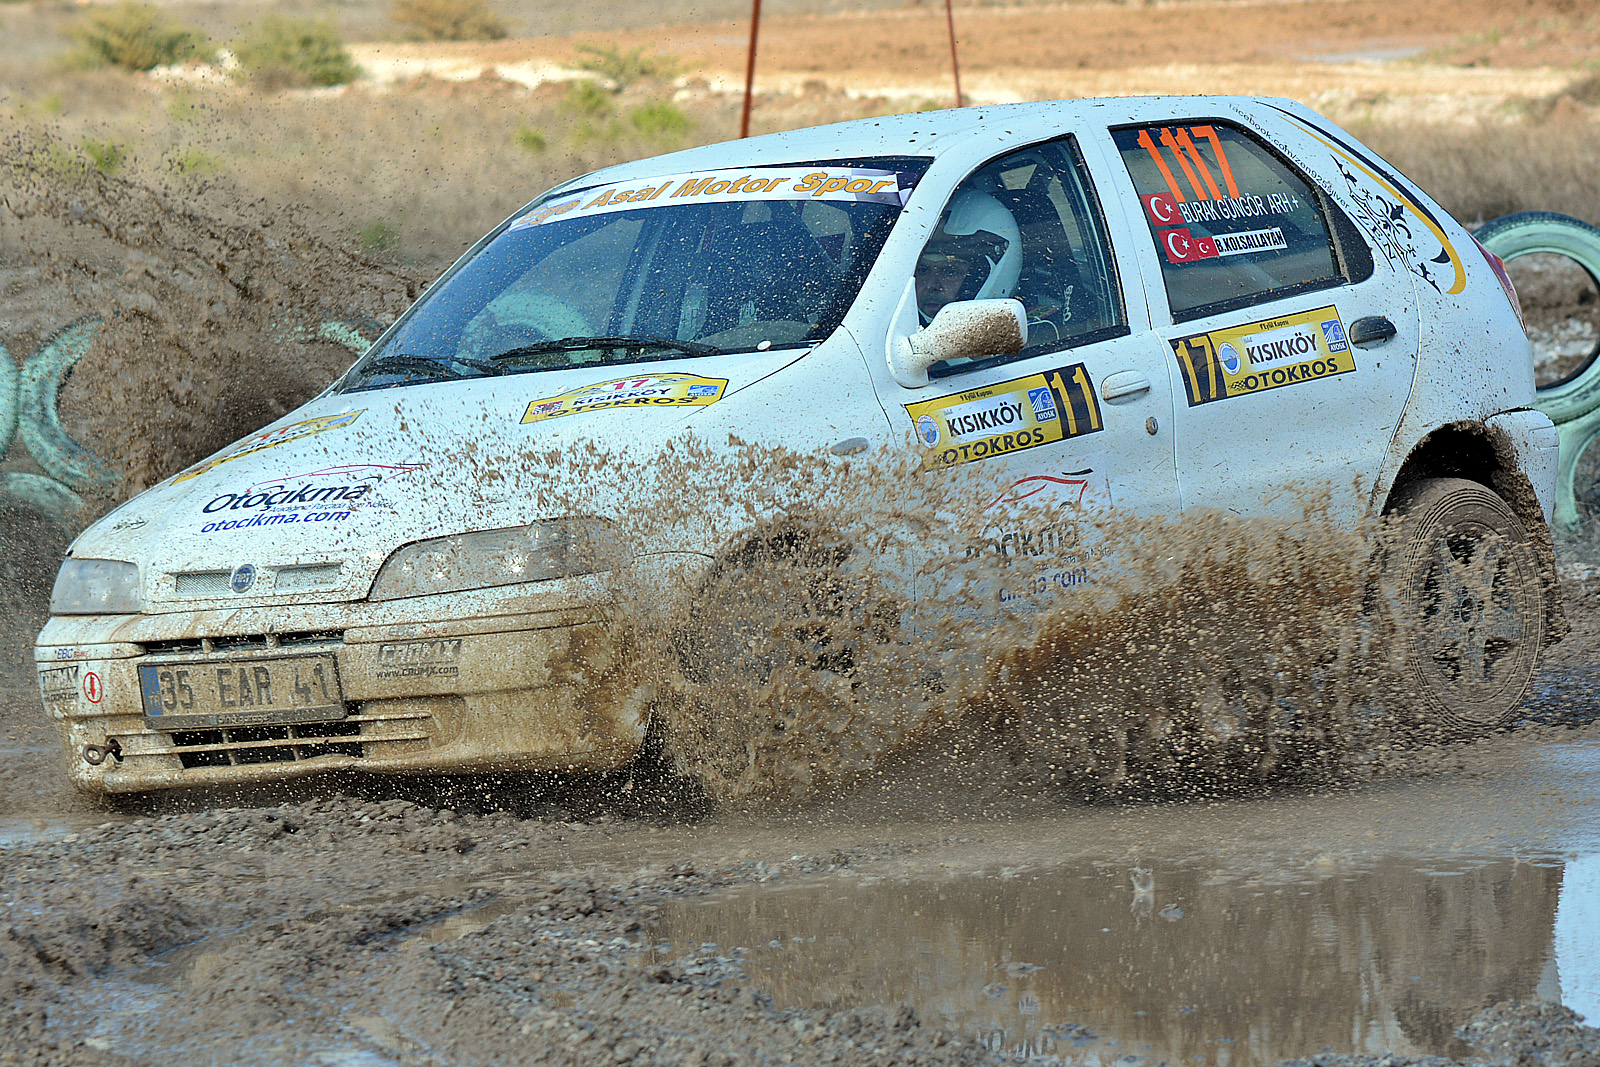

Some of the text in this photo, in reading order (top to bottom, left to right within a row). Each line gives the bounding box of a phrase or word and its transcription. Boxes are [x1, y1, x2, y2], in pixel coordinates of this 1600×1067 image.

[512, 171, 896, 226] Ege Asal Motor Spor
[1178, 200, 1221, 223] BURAK
[1216, 192, 1269, 223] GÜNGÖR
[1267, 192, 1294, 215] ARH
[1214, 231, 1286, 253] B.KOLSALLAYAN
[1357, 209, 1397, 259] ZEN
[1246, 332, 1318, 364] KISIKKÖY
[613, 378, 650, 390] 17
[1176, 335, 1217, 402] 17
[1245, 358, 1338, 390] OTOKROS
[548, 396, 698, 418] OTOKROS
[1050, 366, 1099, 434] 11
[946, 401, 1023, 437] KISIKKÖY
[942, 427, 1045, 465] OTOKROS
[201, 510, 351, 534] otocikma.com
[57, 648, 74, 659] EBC
[160, 662, 330, 710] 35 EAR 41
